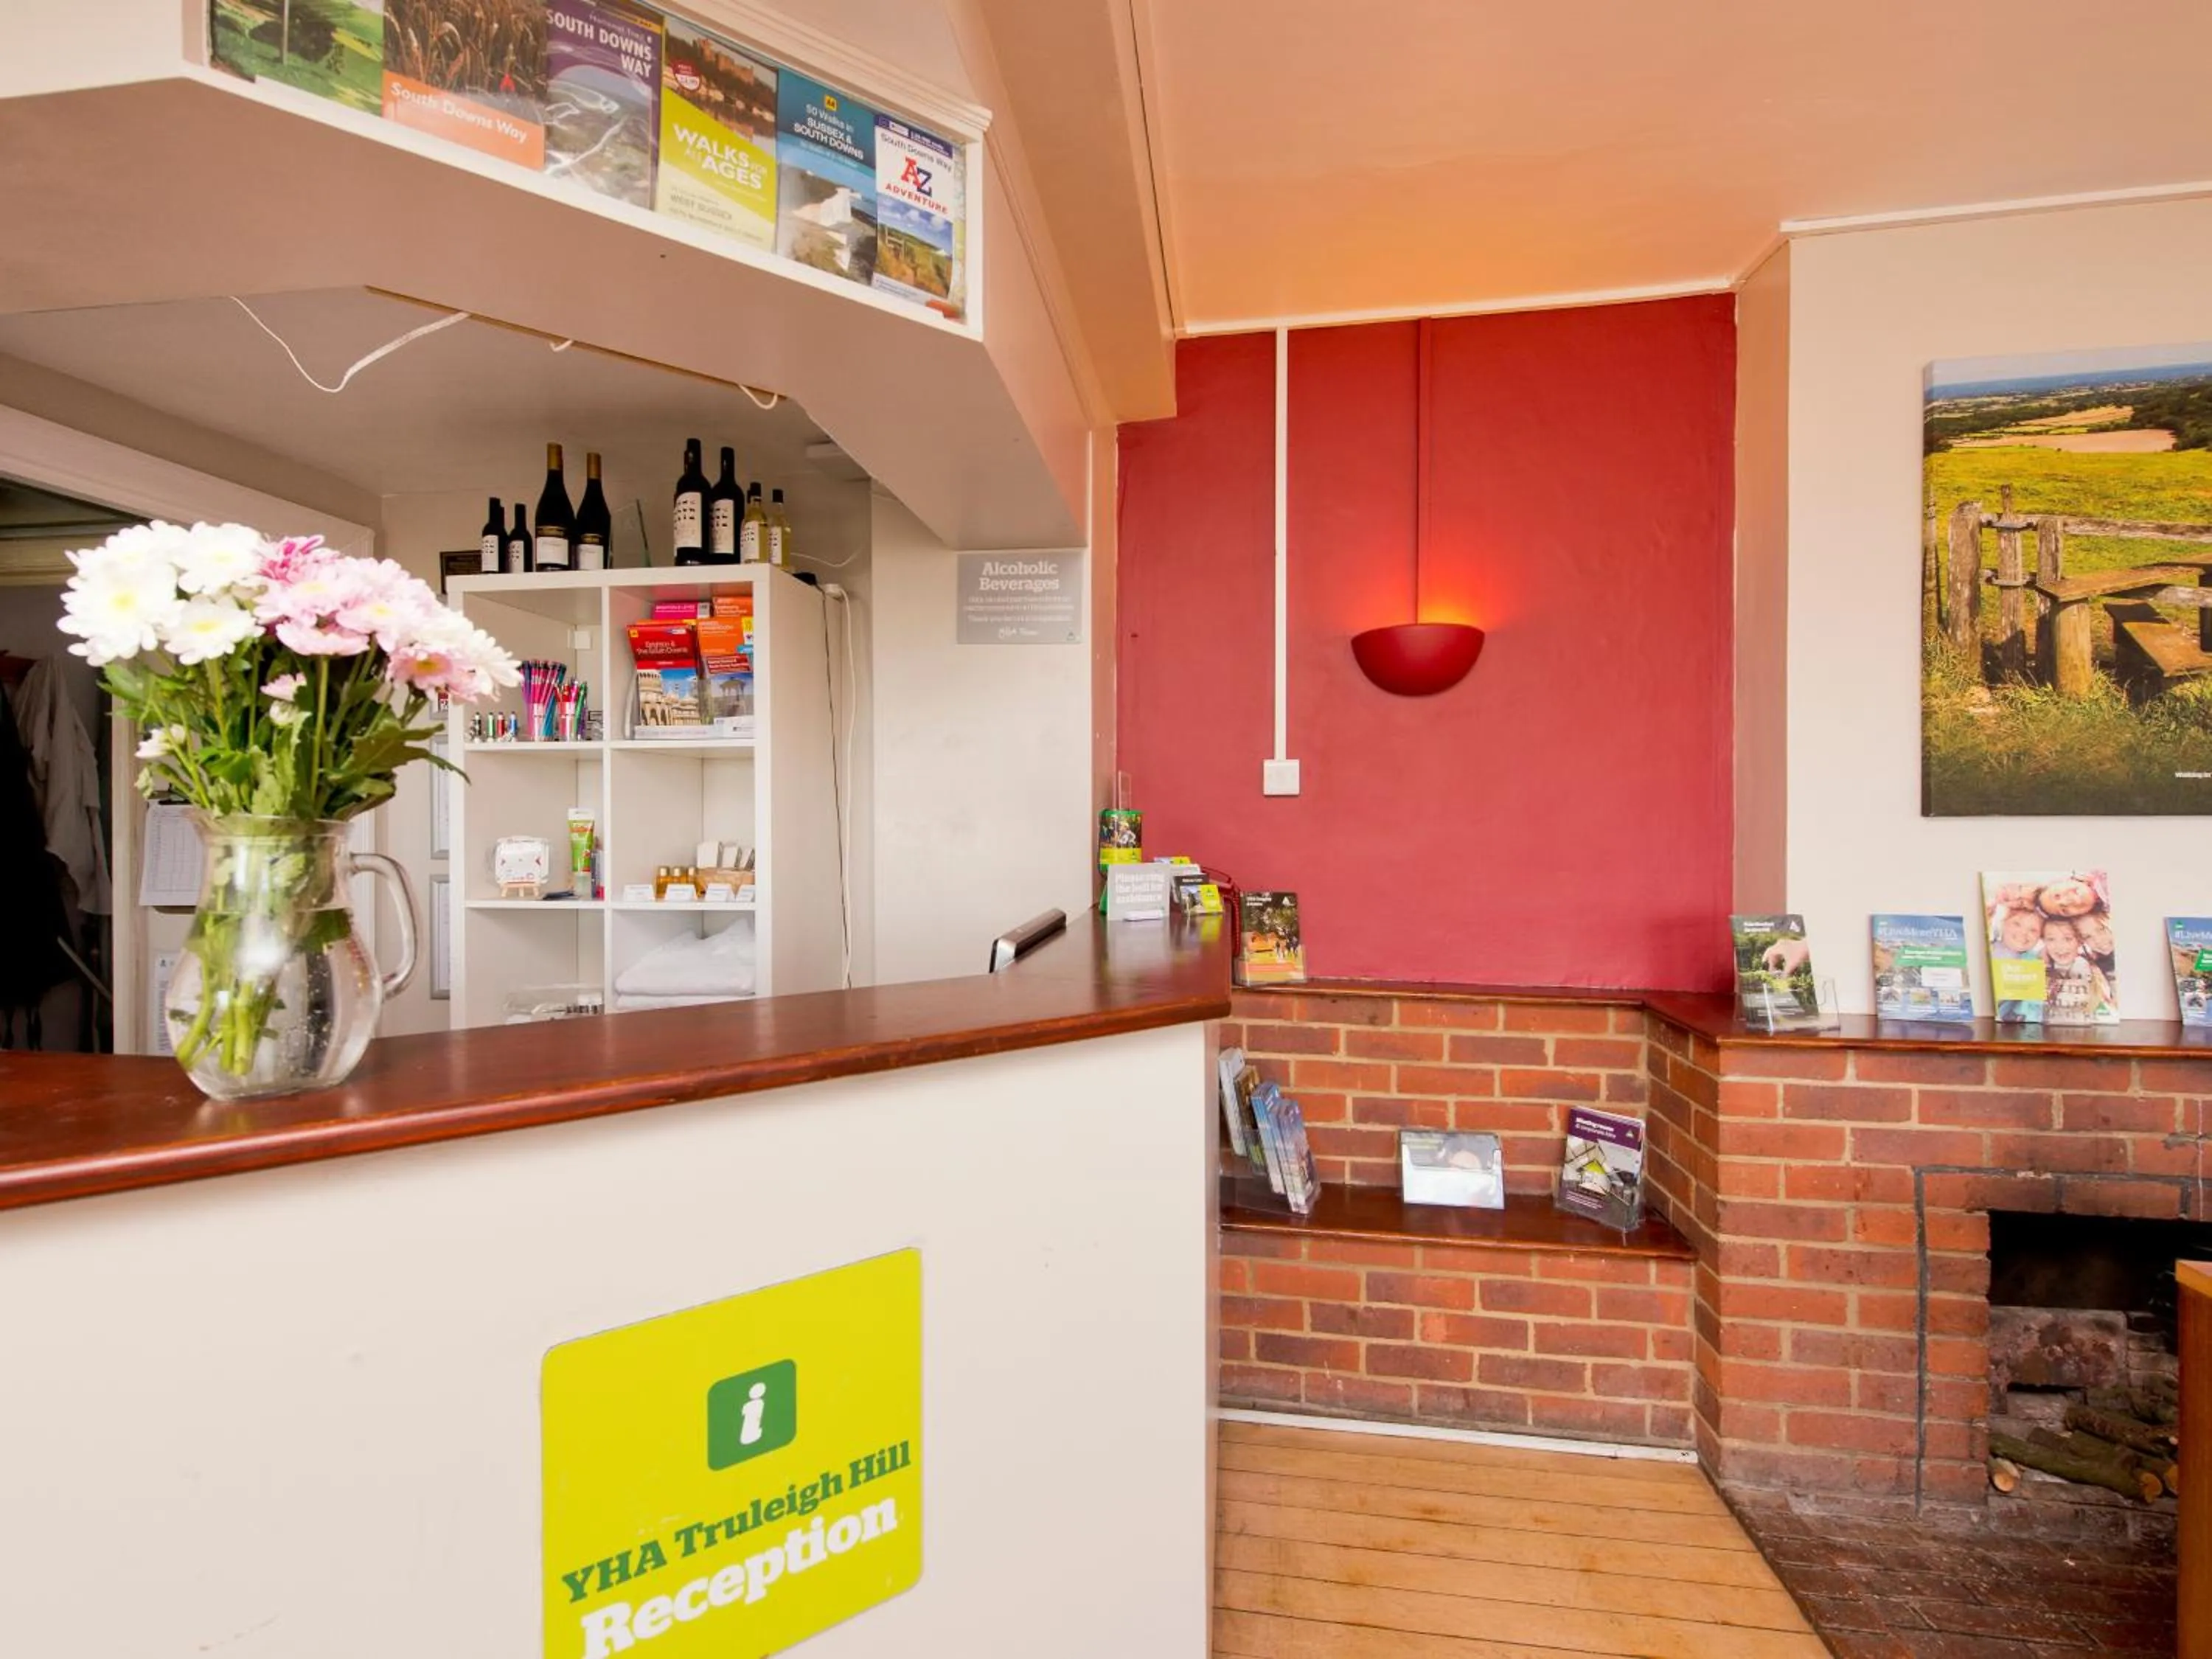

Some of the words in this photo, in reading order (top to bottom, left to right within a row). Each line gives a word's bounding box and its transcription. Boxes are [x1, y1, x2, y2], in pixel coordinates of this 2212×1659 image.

[546, 9, 594, 40] SOUTH
[599, 29, 652, 61] DOWNS
[621, 53, 652, 77] WAY
[390, 81, 439, 109] South
[442, 98, 493, 129] Downs
[496, 113, 528, 143] Way
[672, 123, 749, 168] WALKS
[794, 122, 828, 144] SOUTH
[830, 137, 863, 160] DOWNS
[702, 155, 762, 189] AGES
[885, 183, 948, 215] ADVENTURE
[978, 577, 1060, 592] Beverages
[981, 561, 1059, 576] Alcoholic
[739, 1382, 766, 1445] i
[562, 1540, 667, 1604] YHA
[675, 1470, 843, 1558] Truleigh
[849, 1440, 911, 1489] Hill
[580, 1498, 897, 1659] Reception
